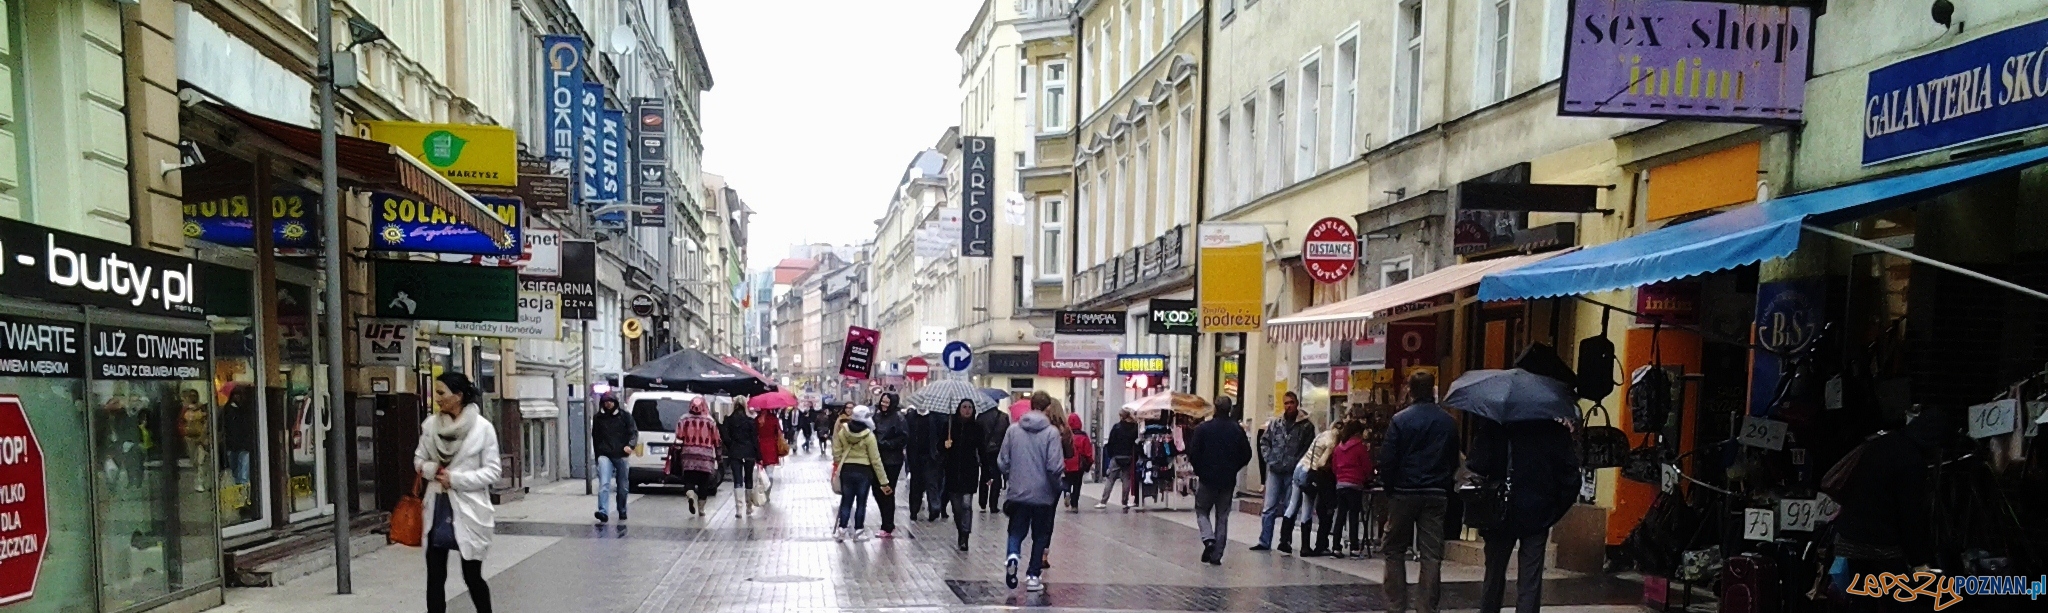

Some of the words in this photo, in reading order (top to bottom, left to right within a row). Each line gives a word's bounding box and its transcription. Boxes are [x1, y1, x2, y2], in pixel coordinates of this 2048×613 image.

[1581, 14, 1664, 47] sex
[1686, 9, 1799, 63] shop
[1865, 63, 1993, 139] GALANTERIA
[603, 118, 618, 206] KURS
[447, 170, 499, 179] MARZYSZ
[1313, 221, 1350, 237] OUTLET
[1310, 243, 1352, 255] DISTANCE
[48, 233, 193, 310] buty.pl
[1311, 262, 1348, 279] OUTLET
[365, 324, 408, 340] UFC
[93, 329, 128, 357] JUŻ
[136, 333, 205, 361] OTWARTE
[1, 510, 22, 533] DLA
